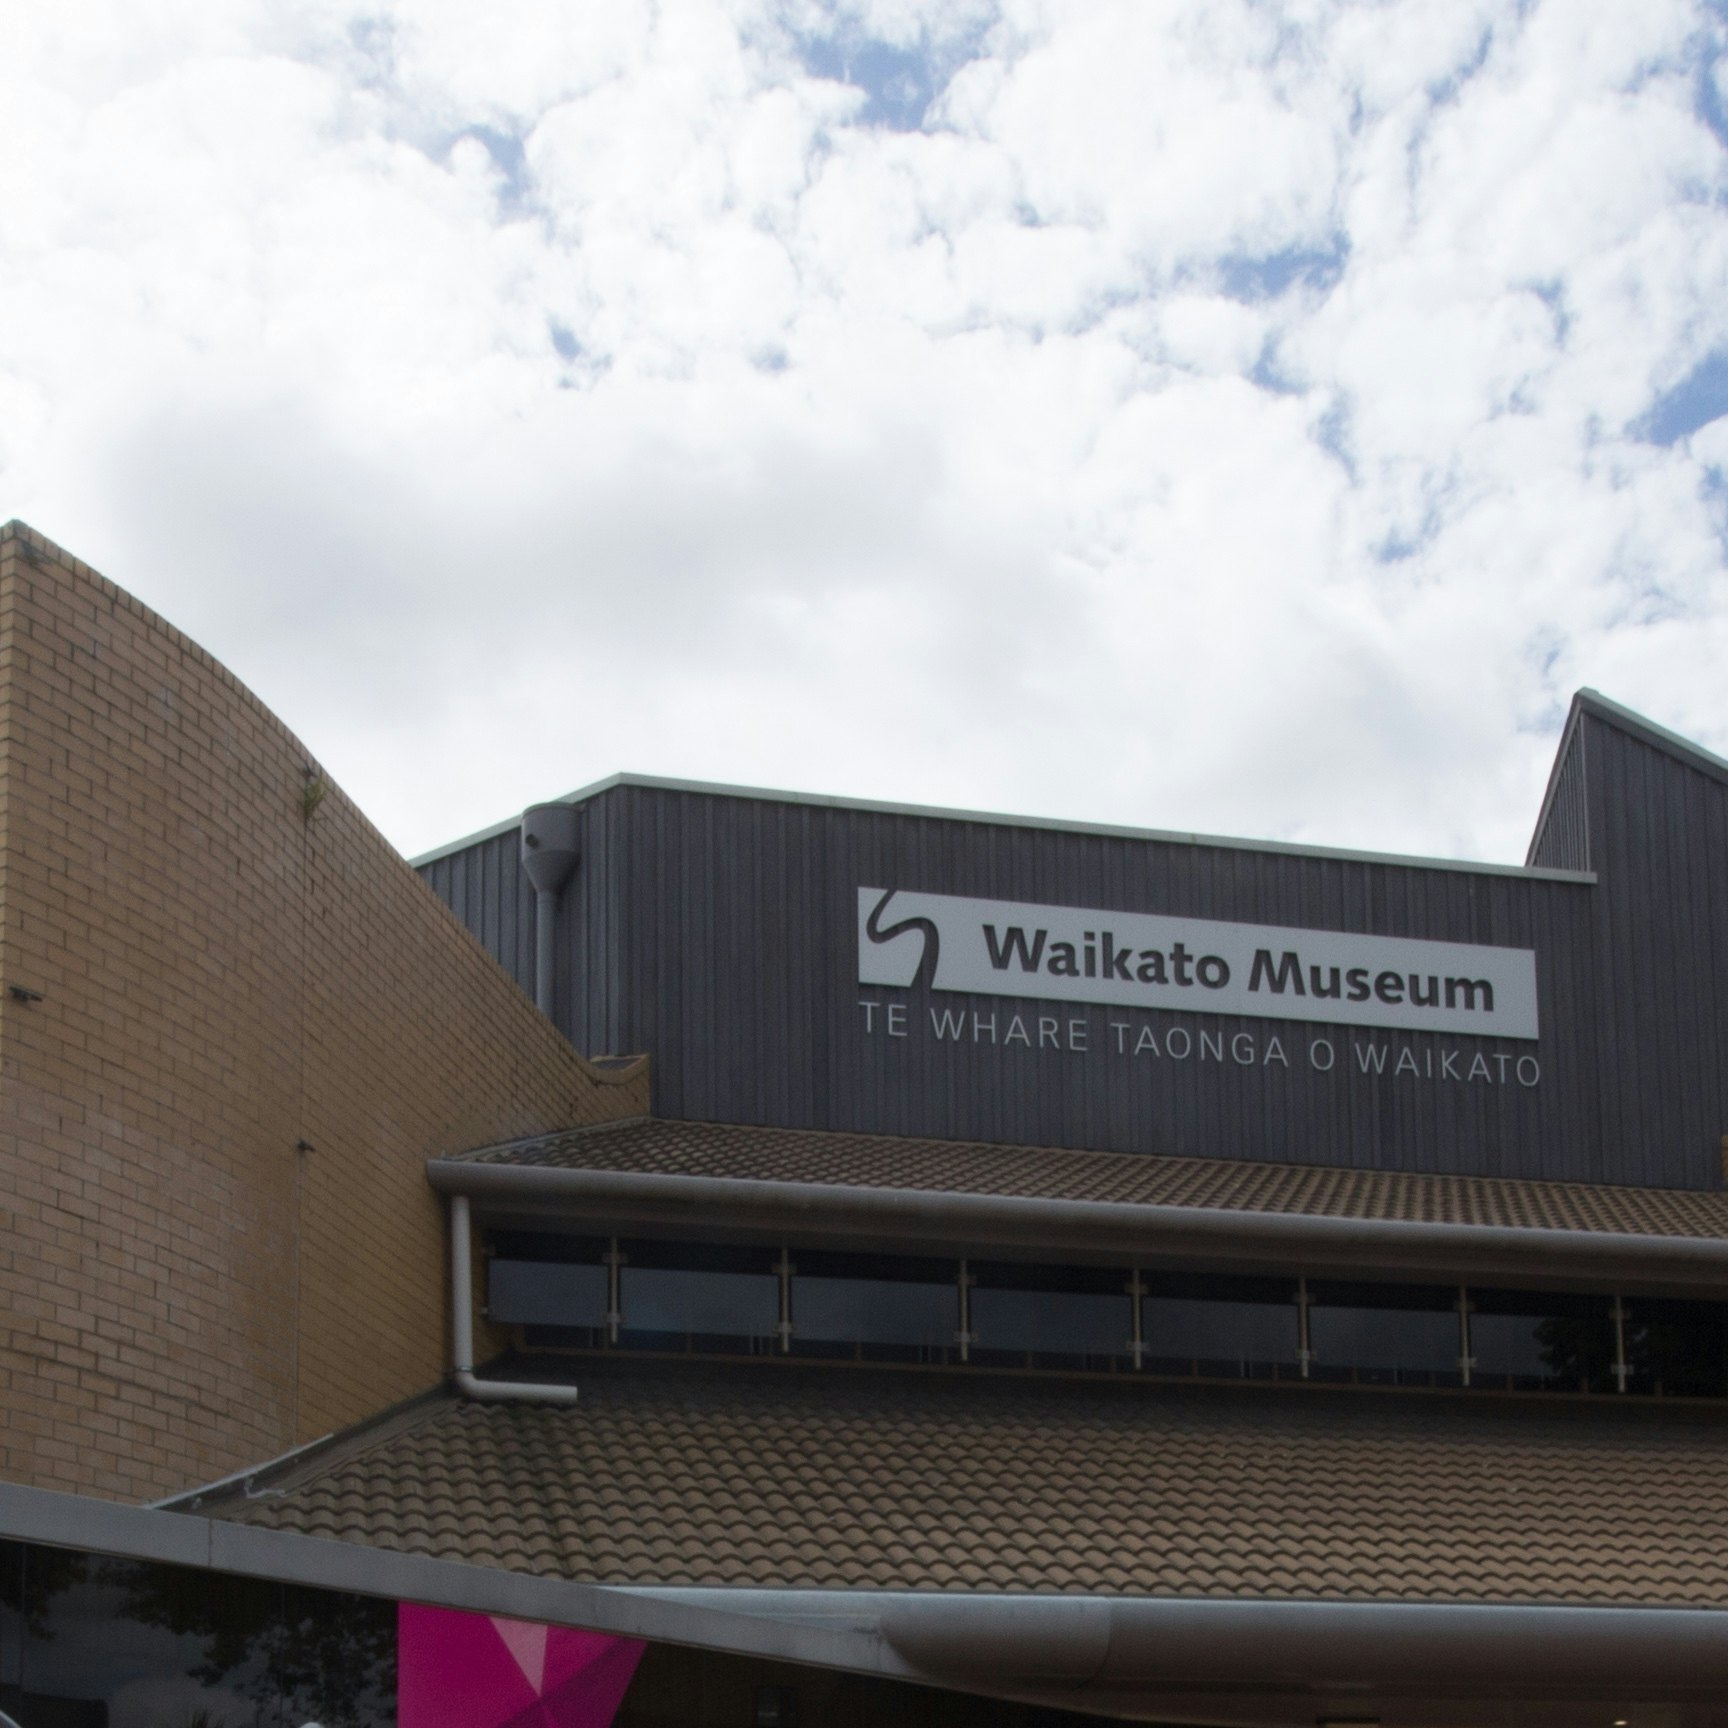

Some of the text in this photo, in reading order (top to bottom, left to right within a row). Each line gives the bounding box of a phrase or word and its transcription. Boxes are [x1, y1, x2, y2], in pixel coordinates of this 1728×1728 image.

[981, 923, 1494, 1013] Waikato Museum
[858, 1001, 1540, 1088] TE WHARE TAONGA O WAIKATO
